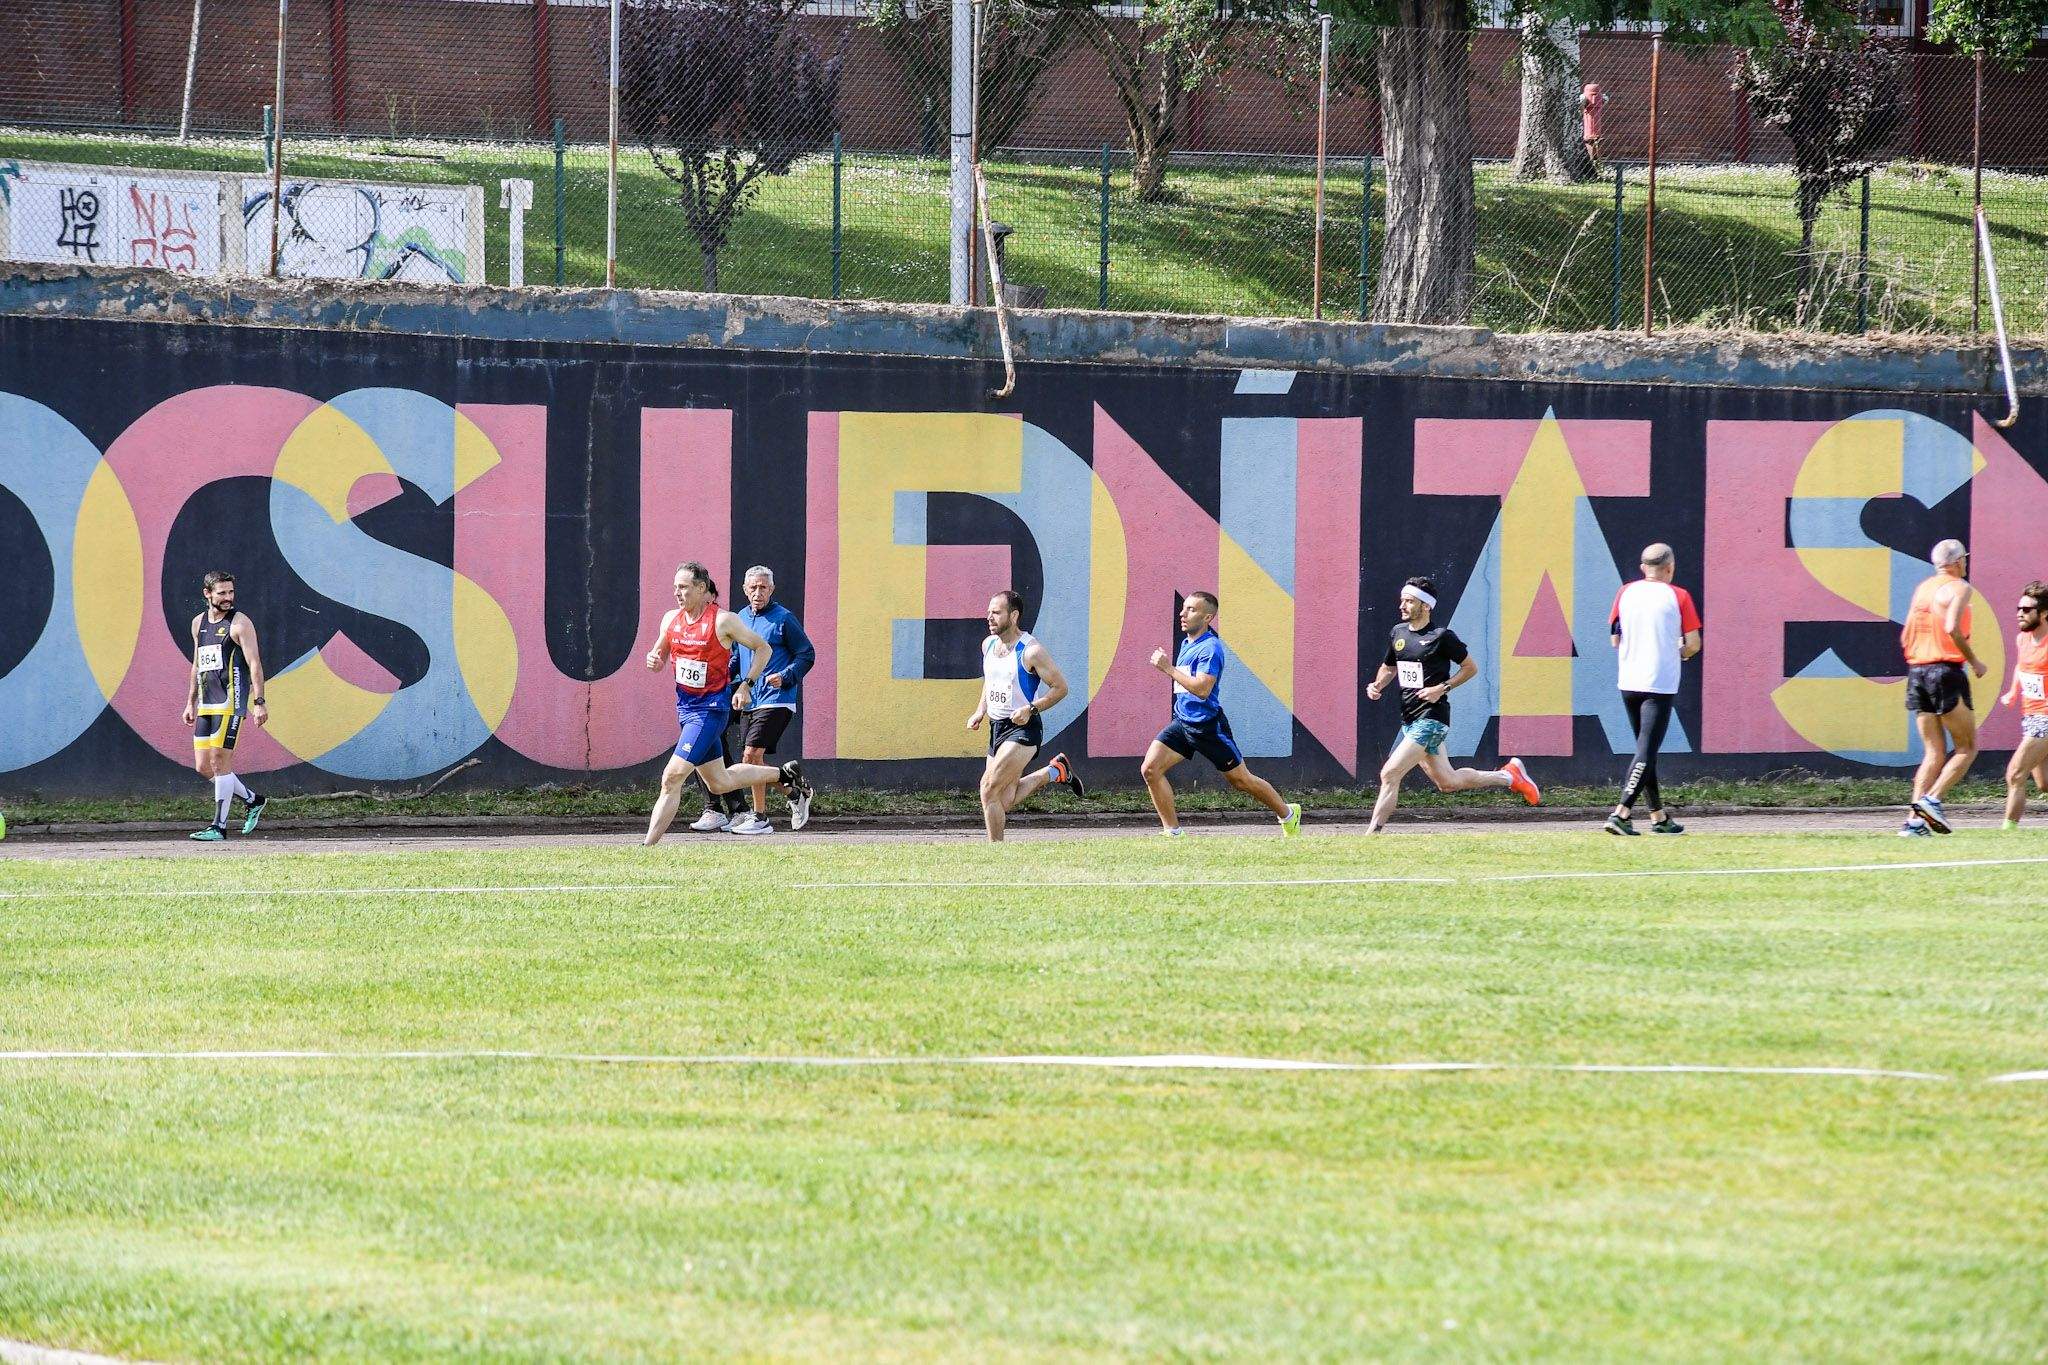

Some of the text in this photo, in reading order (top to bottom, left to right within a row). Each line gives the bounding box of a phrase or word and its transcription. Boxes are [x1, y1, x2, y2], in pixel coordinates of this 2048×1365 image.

[201, 653, 217, 666] 864
[680, 667, 700, 681] 736
[1403, 670, 1417, 682] 769
[990, 691, 1006, 703] 886
